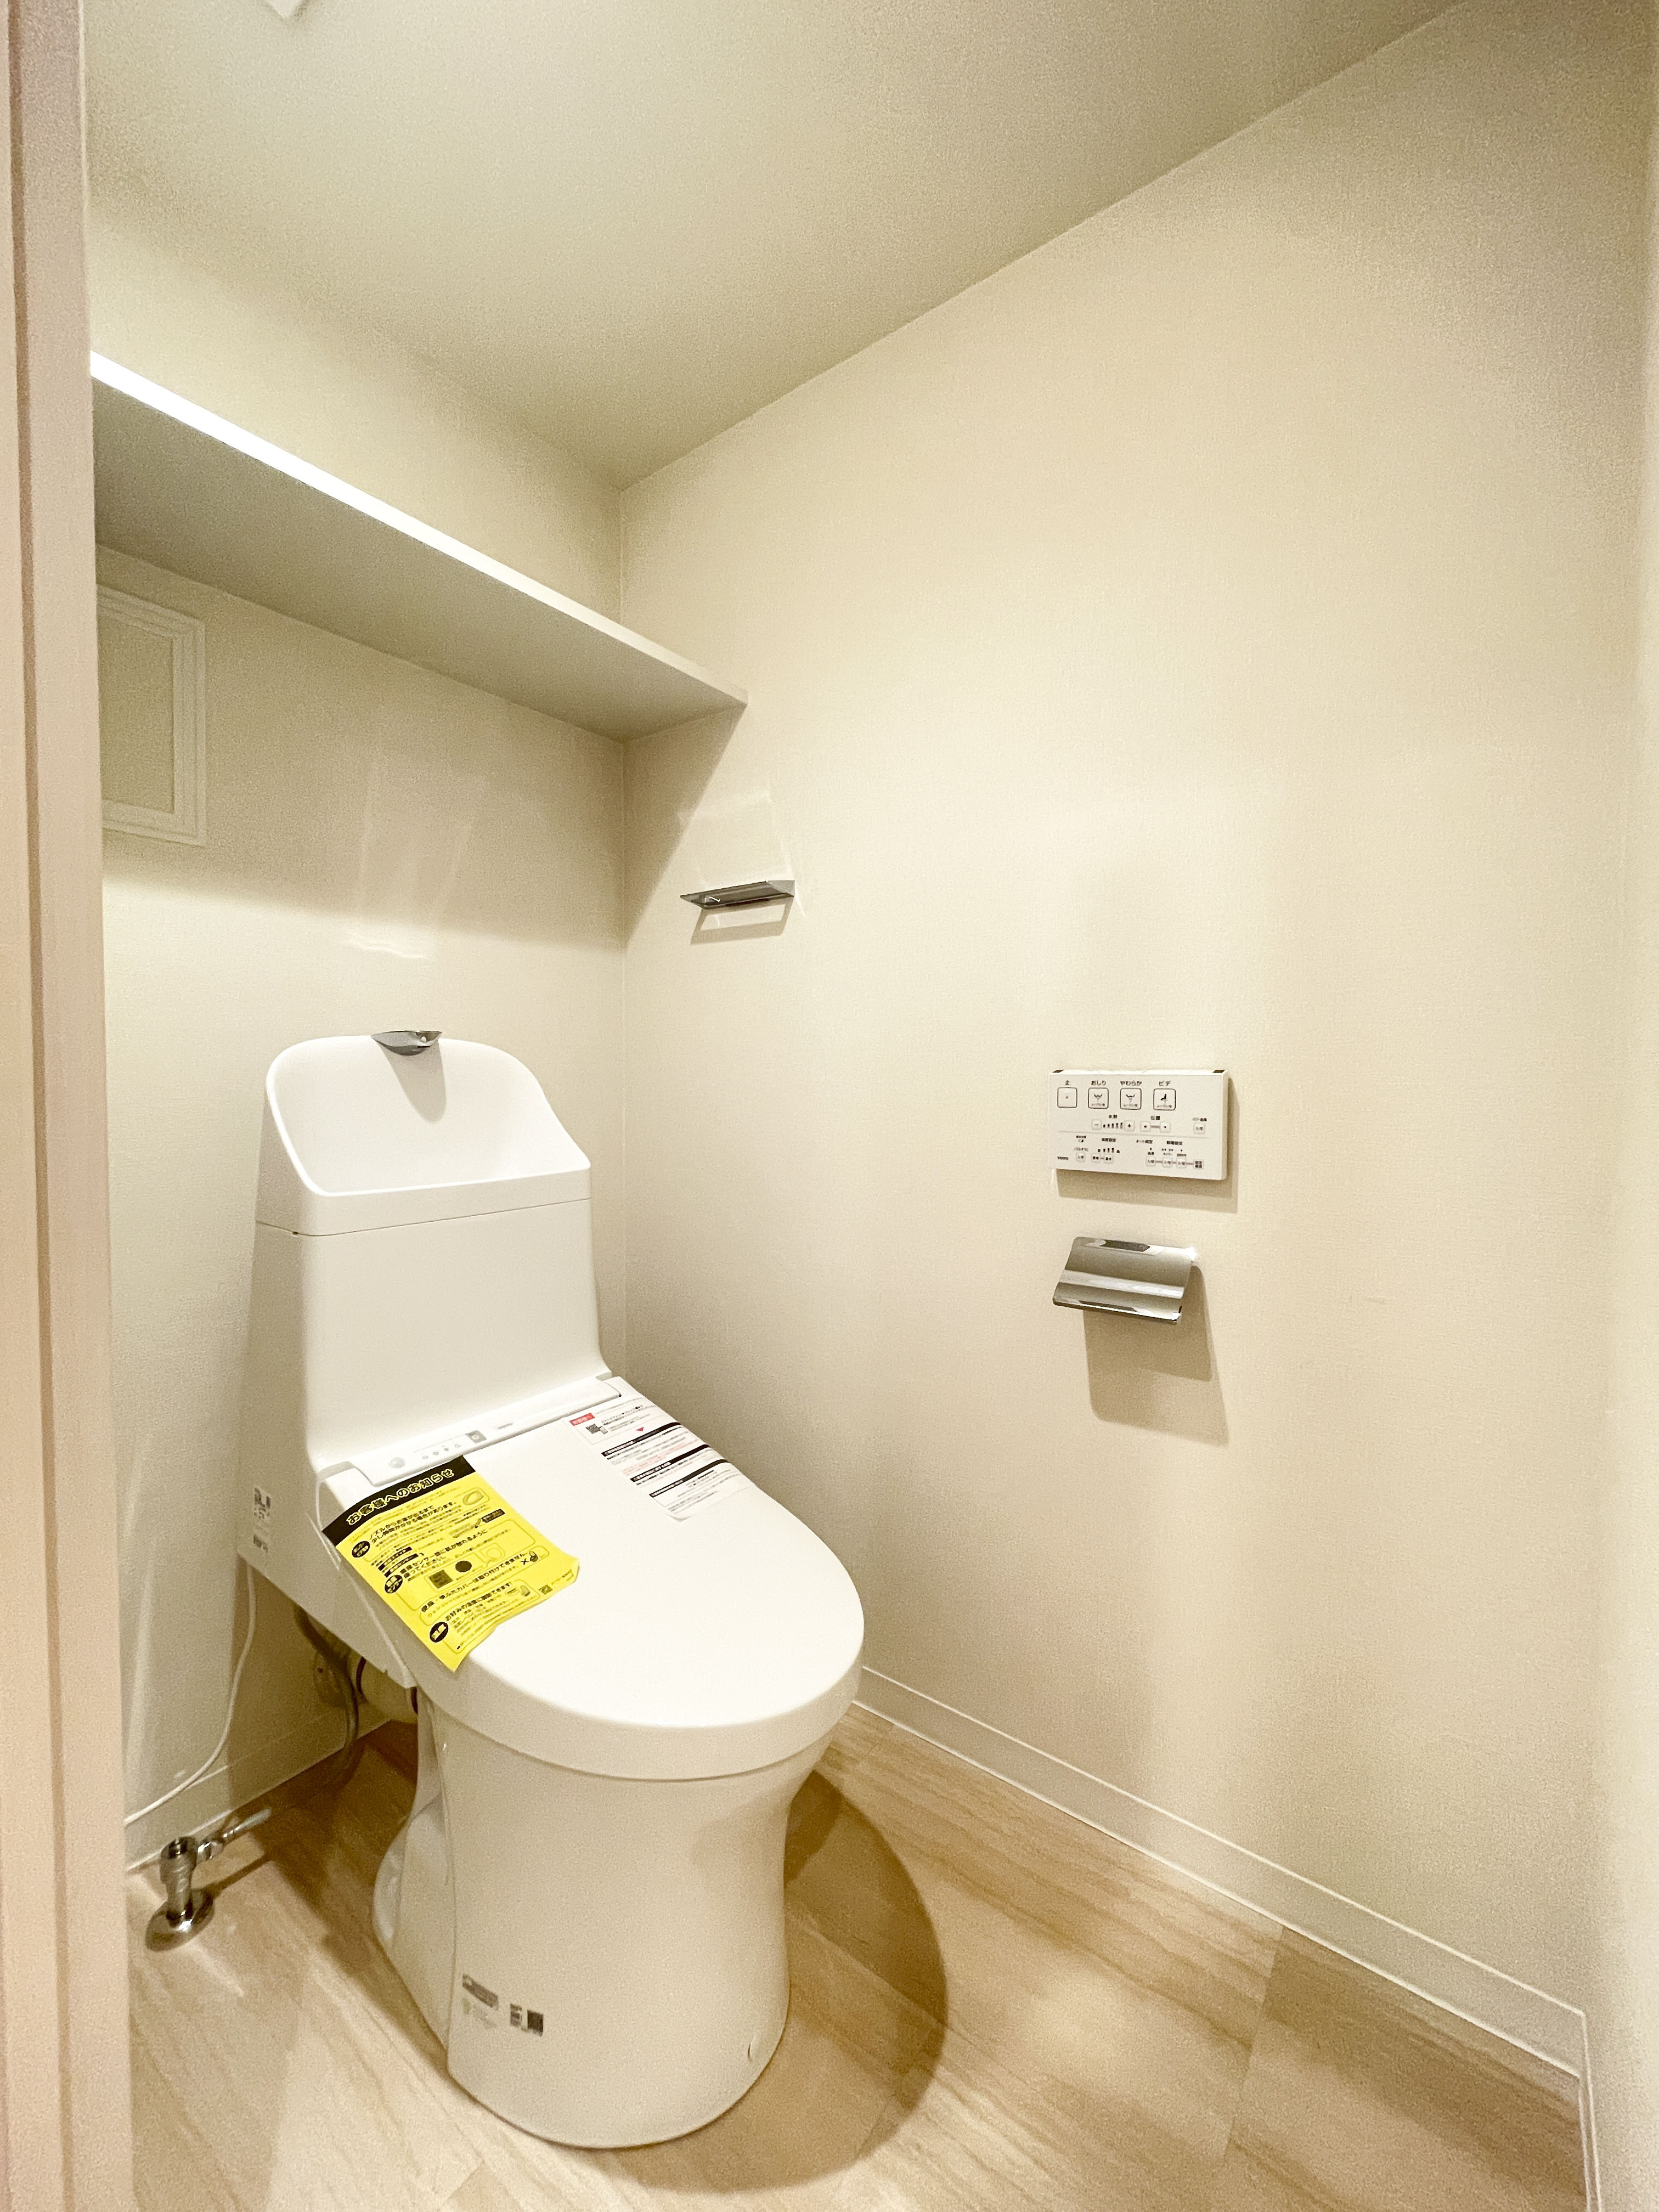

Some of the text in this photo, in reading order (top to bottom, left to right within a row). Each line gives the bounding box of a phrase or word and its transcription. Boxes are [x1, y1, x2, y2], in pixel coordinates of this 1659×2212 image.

[346, 1468, 455, 1525] お客様へのお知らせ
